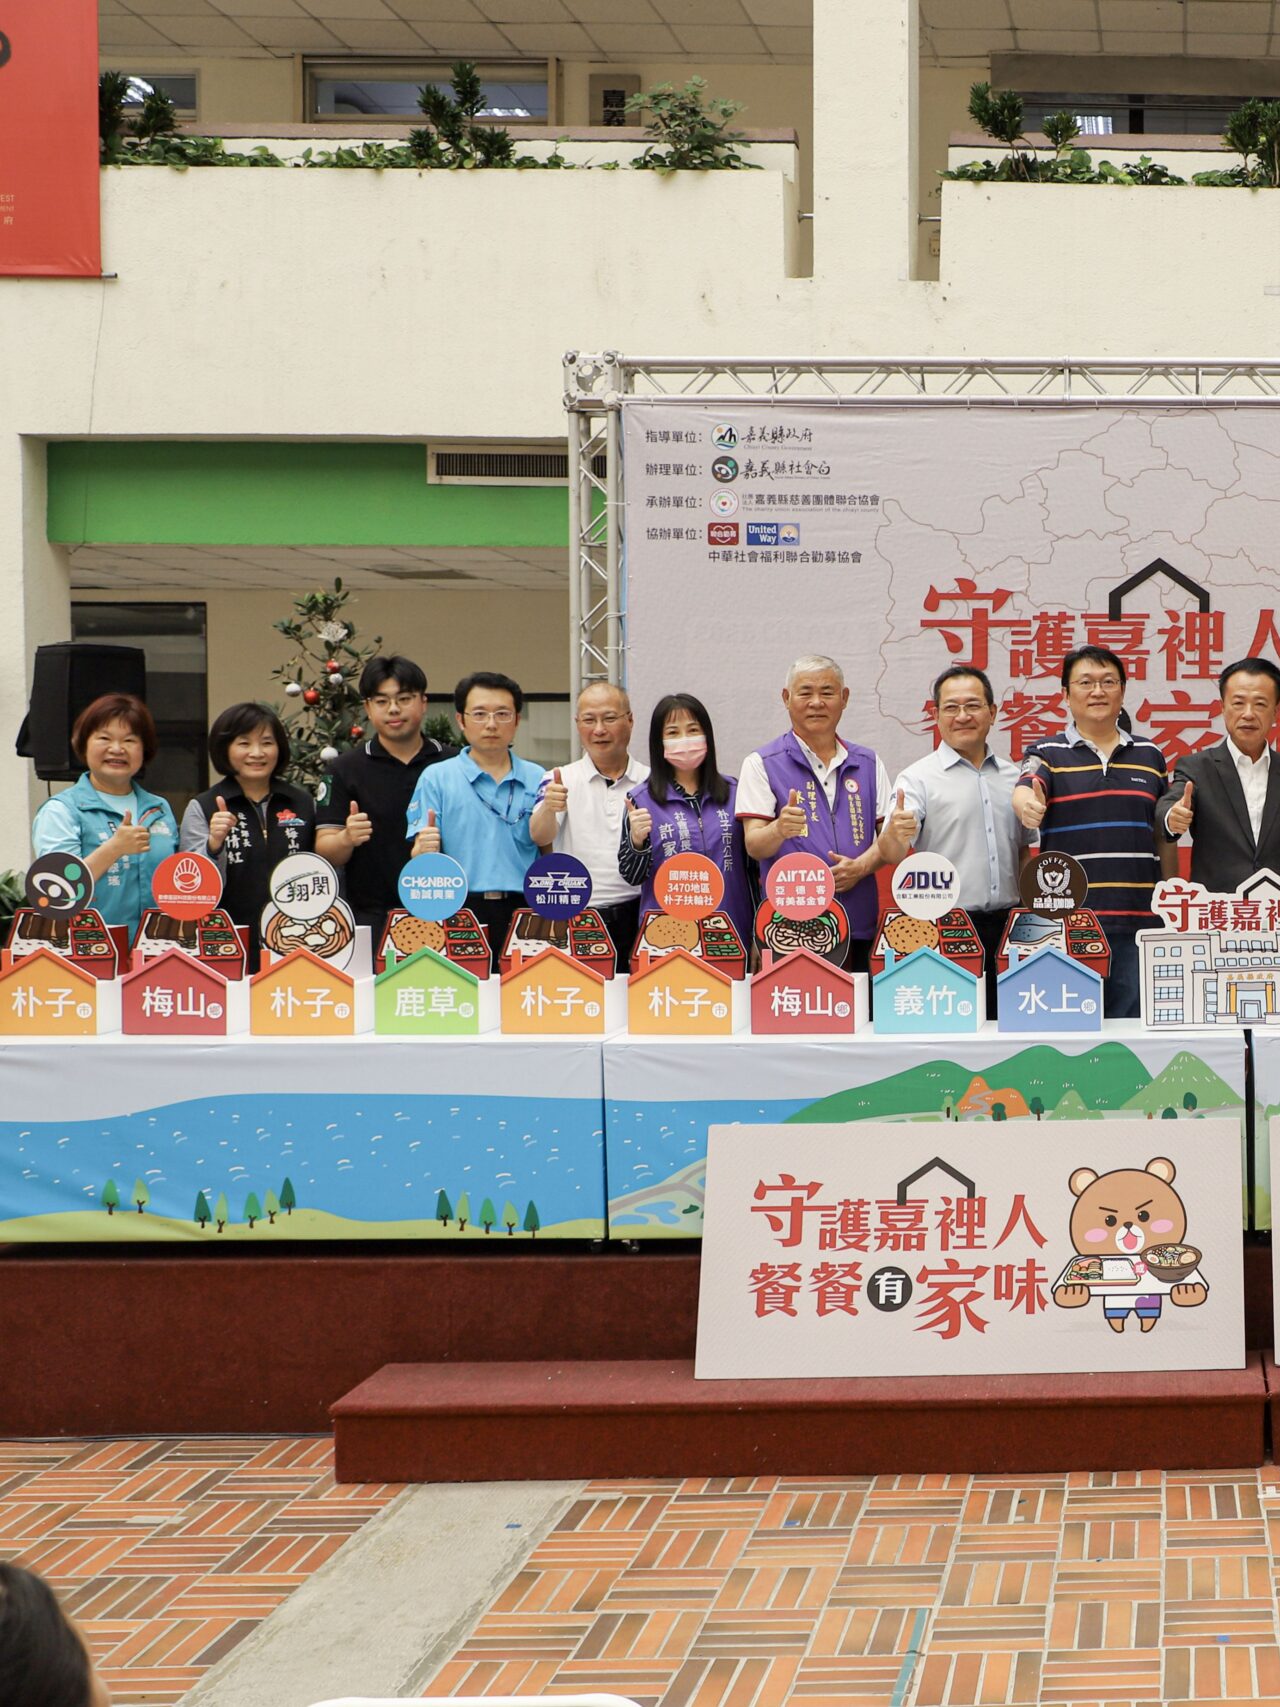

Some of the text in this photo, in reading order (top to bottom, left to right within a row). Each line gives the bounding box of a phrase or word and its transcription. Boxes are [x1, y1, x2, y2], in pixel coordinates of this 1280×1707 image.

[741, 425, 813, 444] 嘉義縣政府
[748, 524, 777, 534] United
[759, 534, 777, 544] Way
[708, 550, 863, 563] 中華社會福利聯合勸募協會
[658, 822, 678, 861] 許家
[1038, 857, 1069, 869] COFFEE
[668, 870, 709, 881] 國際扶輪
[897, 871, 955, 889] ADLY
[401, 876, 464, 888] CHENBRO
[667, 882, 711, 893] 3470地區
[535, 894, 581, 905] 松川精密
[663, 894, 714, 906] 朴子扶輪社
[750, 1173, 1049, 1252] 守護嘉裡人
[749, 1258, 1050, 1340] 餐餐有家味
